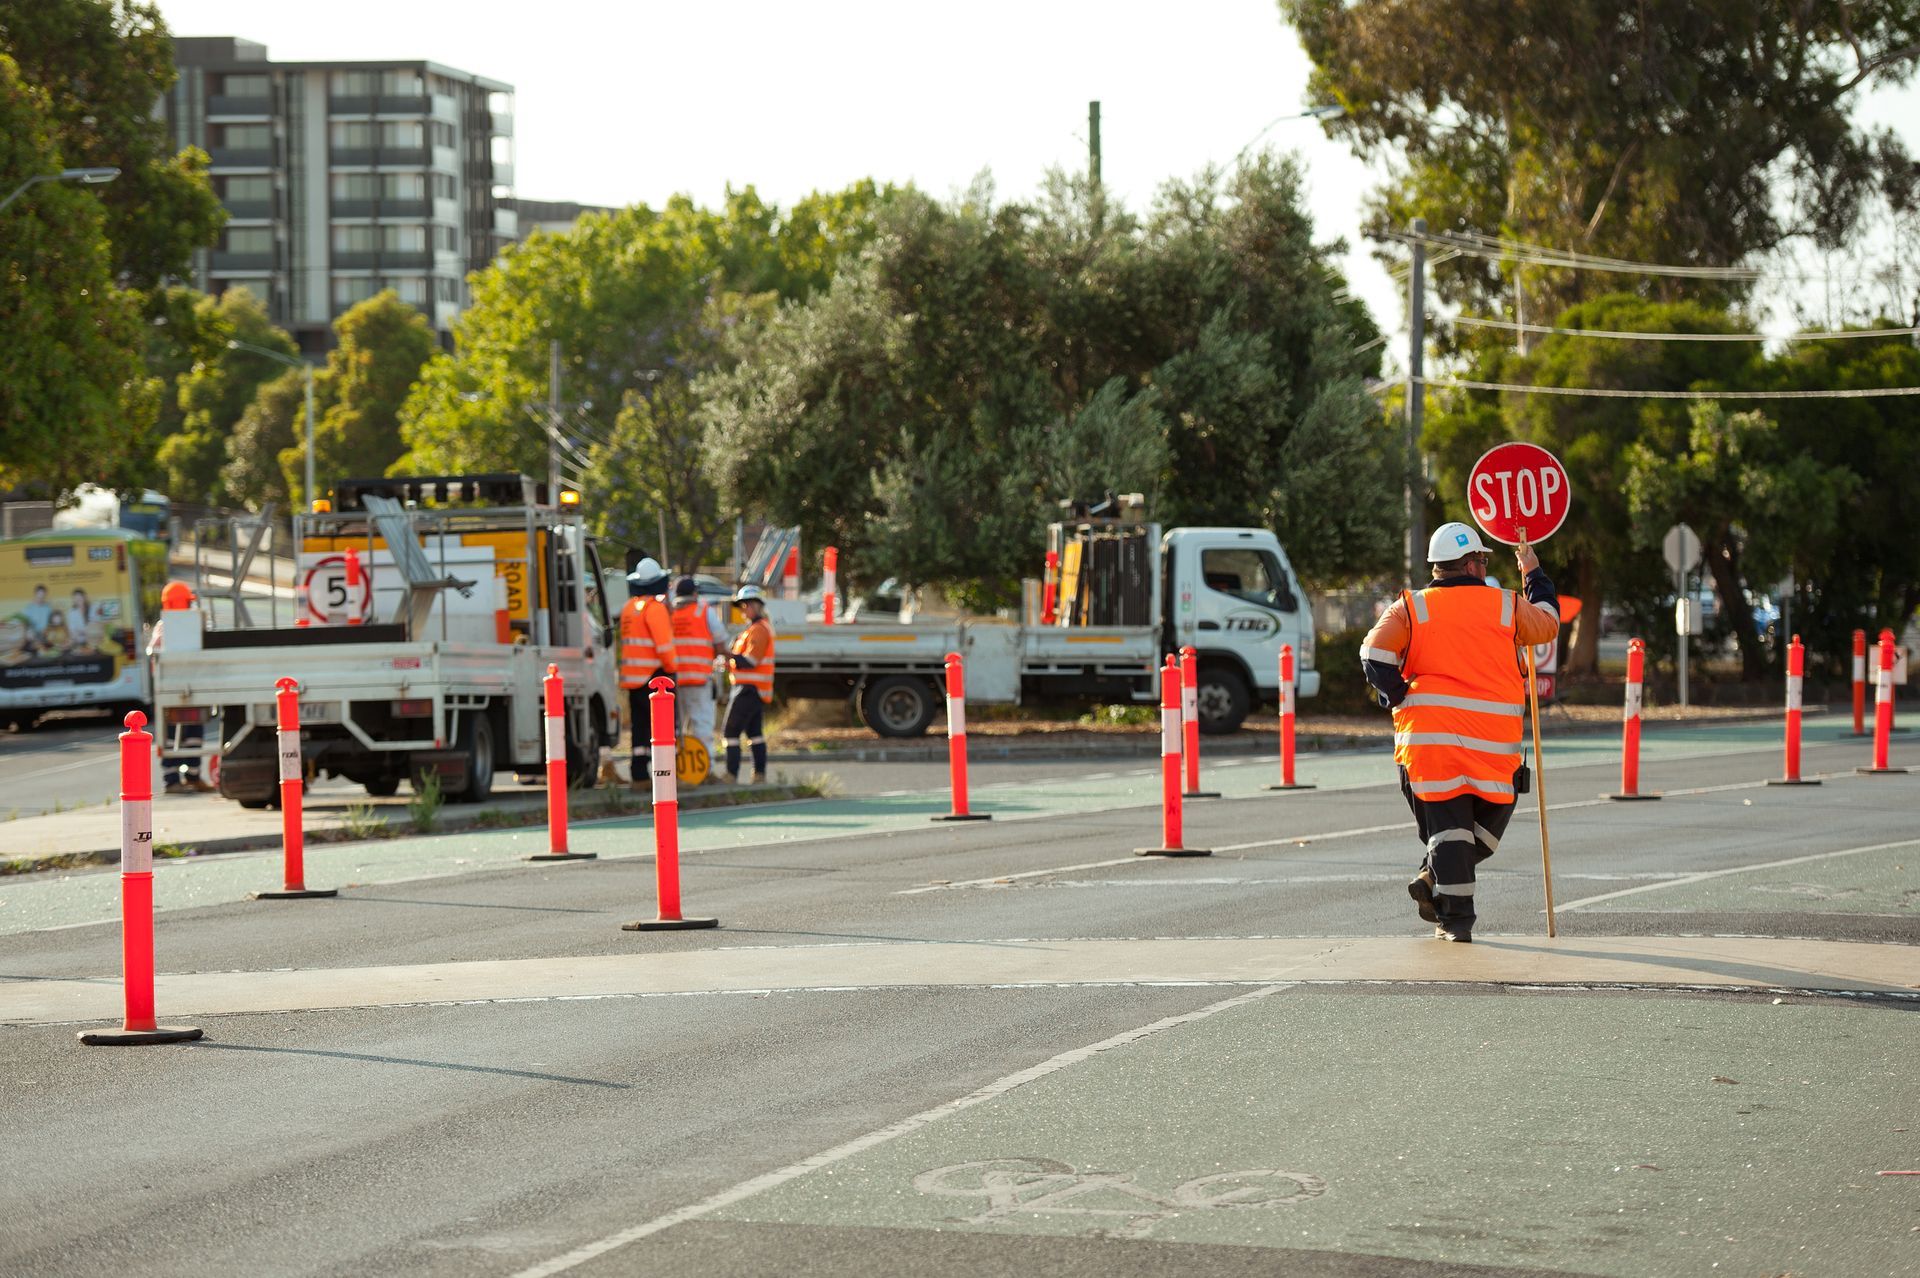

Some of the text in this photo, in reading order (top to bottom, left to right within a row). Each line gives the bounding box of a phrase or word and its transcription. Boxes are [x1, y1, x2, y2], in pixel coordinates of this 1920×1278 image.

[1475, 466, 1560, 521] STOP
[328, 576, 347, 607] 5
[1525, 678, 1551, 695] SOP
[676, 749, 706, 775] SLO
